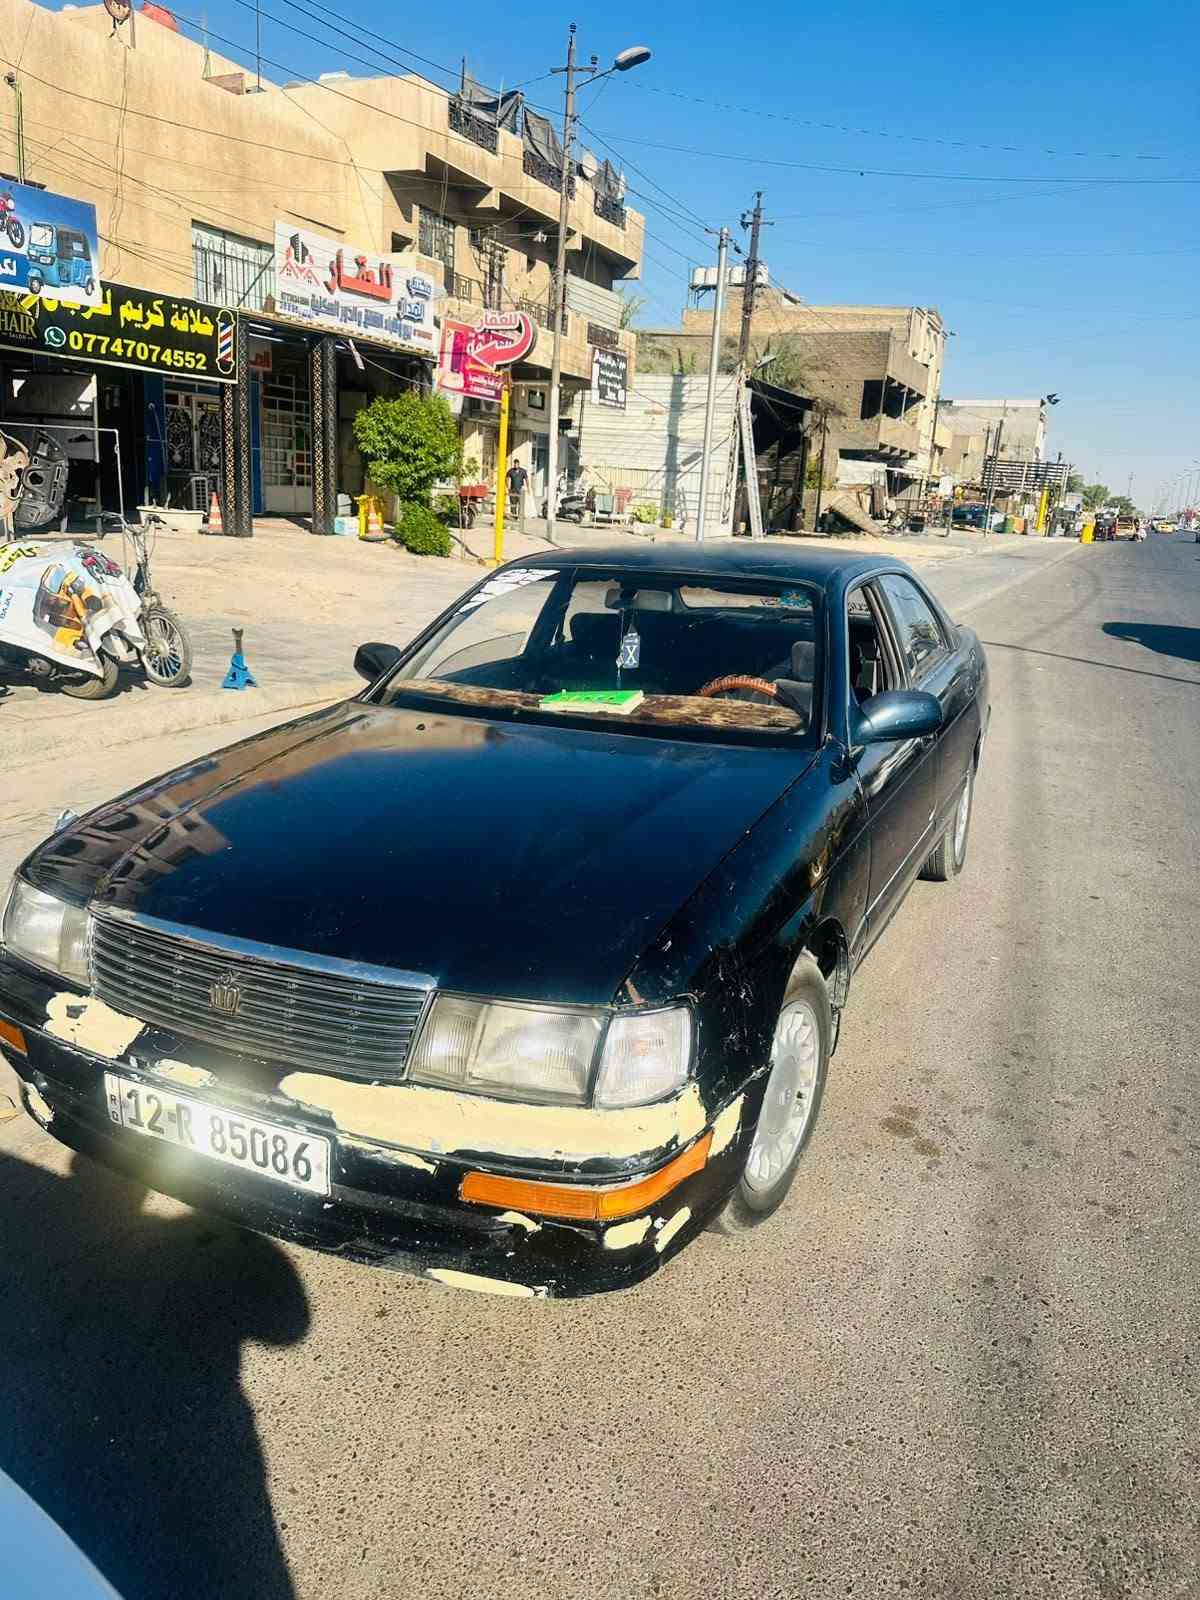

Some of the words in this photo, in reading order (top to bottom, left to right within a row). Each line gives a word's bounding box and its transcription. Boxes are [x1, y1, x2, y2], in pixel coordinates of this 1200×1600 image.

[0, 311, 38, 339] HAIR
[119, 300, 165, 330] كريم
[170, 303, 215, 337] حلاقة
[69, 331, 207, 371] 07747074552
[126, 1088, 195, 1145] 12-R
[209, 1116, 312, 1183] 85086
